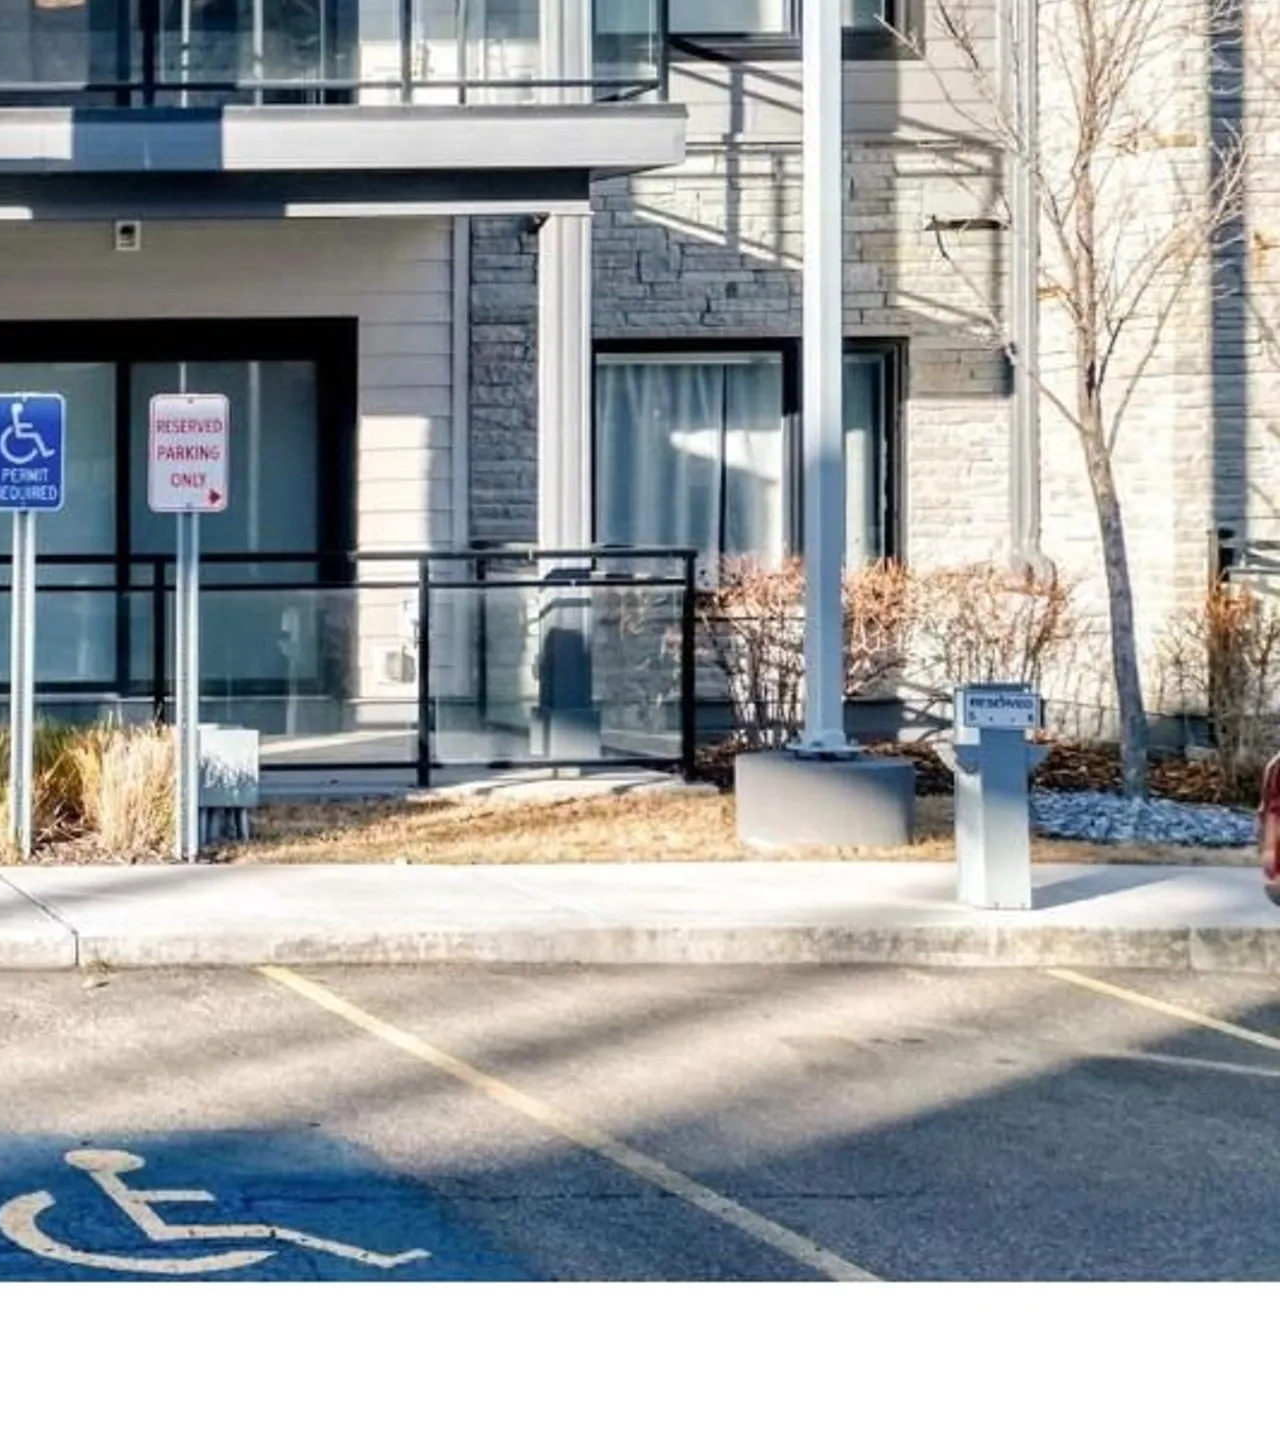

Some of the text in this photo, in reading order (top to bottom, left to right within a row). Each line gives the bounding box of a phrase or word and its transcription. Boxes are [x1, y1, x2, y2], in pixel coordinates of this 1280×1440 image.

[157, 419, 222, 433] RESERVED
[157, 445, 220, 461] PARKING
[1, 467, 48, 483] PERMIT
[171, 473, 206, 488] ONLY
